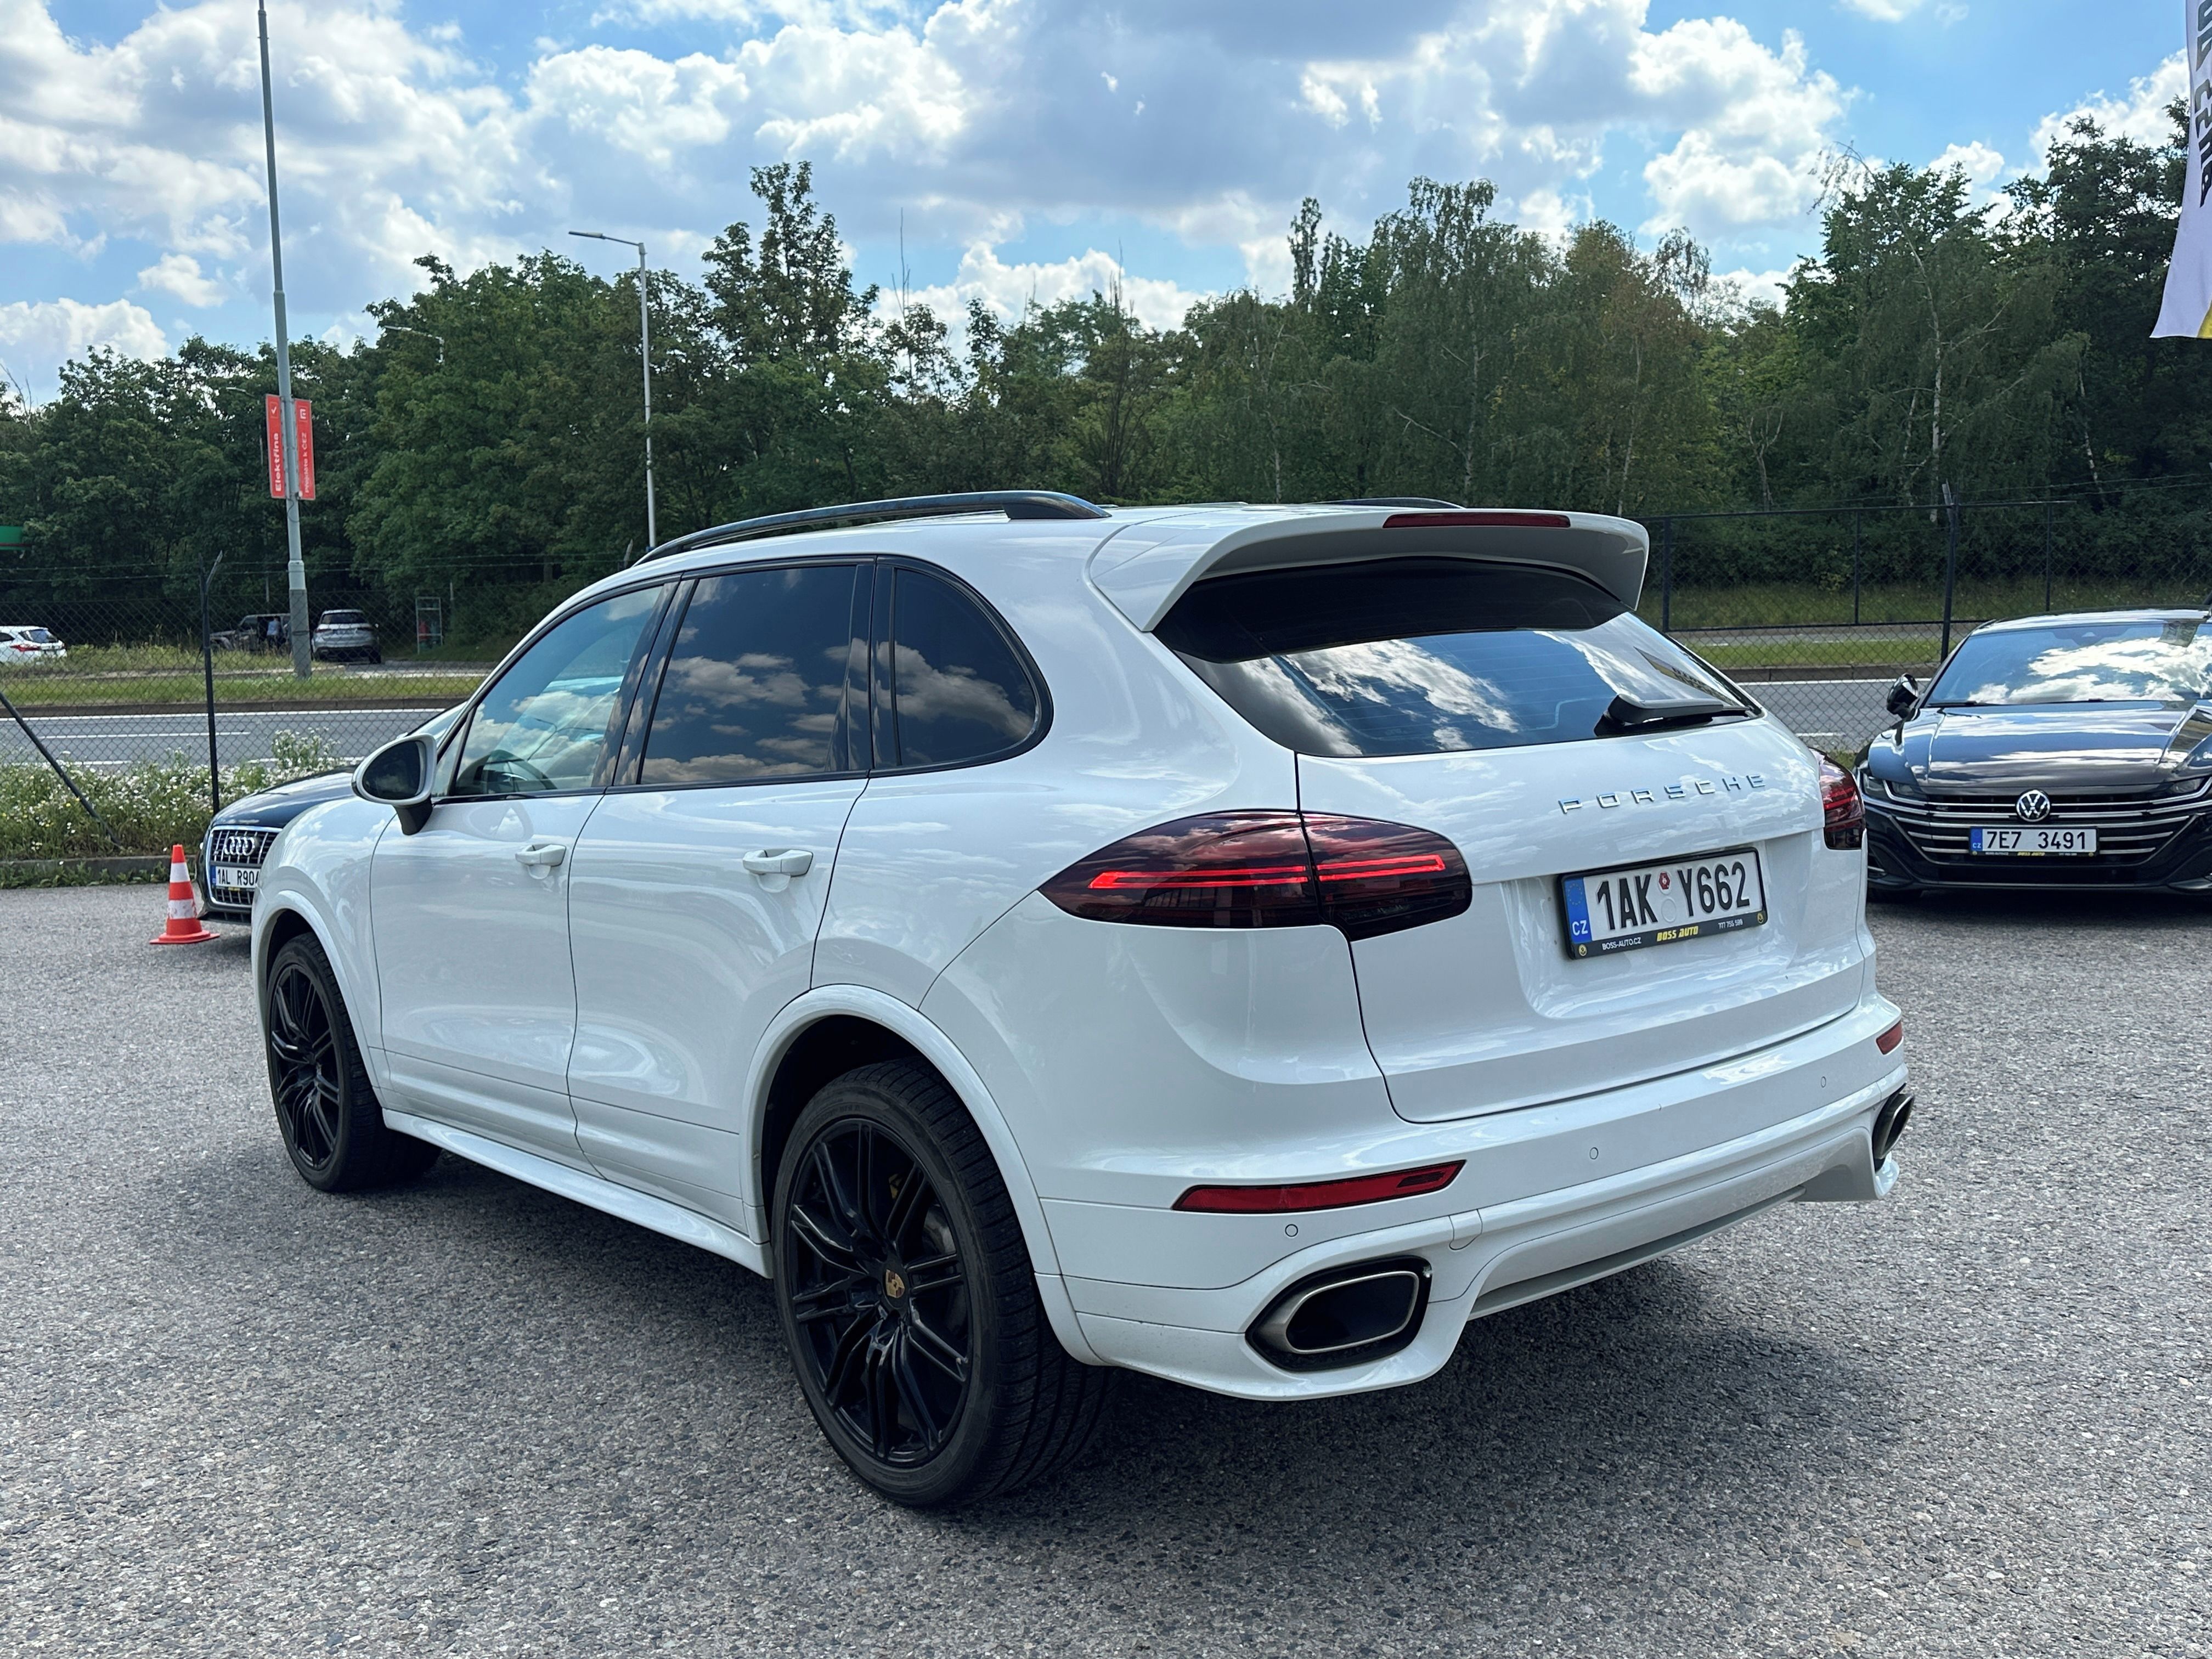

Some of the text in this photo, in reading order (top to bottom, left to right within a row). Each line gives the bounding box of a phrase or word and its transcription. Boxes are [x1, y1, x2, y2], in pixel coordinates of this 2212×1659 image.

[1559, 774, 1766, 814] PORSCHE
[1987, 831, 2085, 849] 7E7 3491
[217, 869, 230, 885] 1AL
[1597, 861, 1750, 930] 1AK Y662
[1572, 919, 1588, 935] CZ
[1656, 926, 1699, 942] BOSS AUTO
[1602, 937, 1641, 951] BOSS-AUTO.CZ
